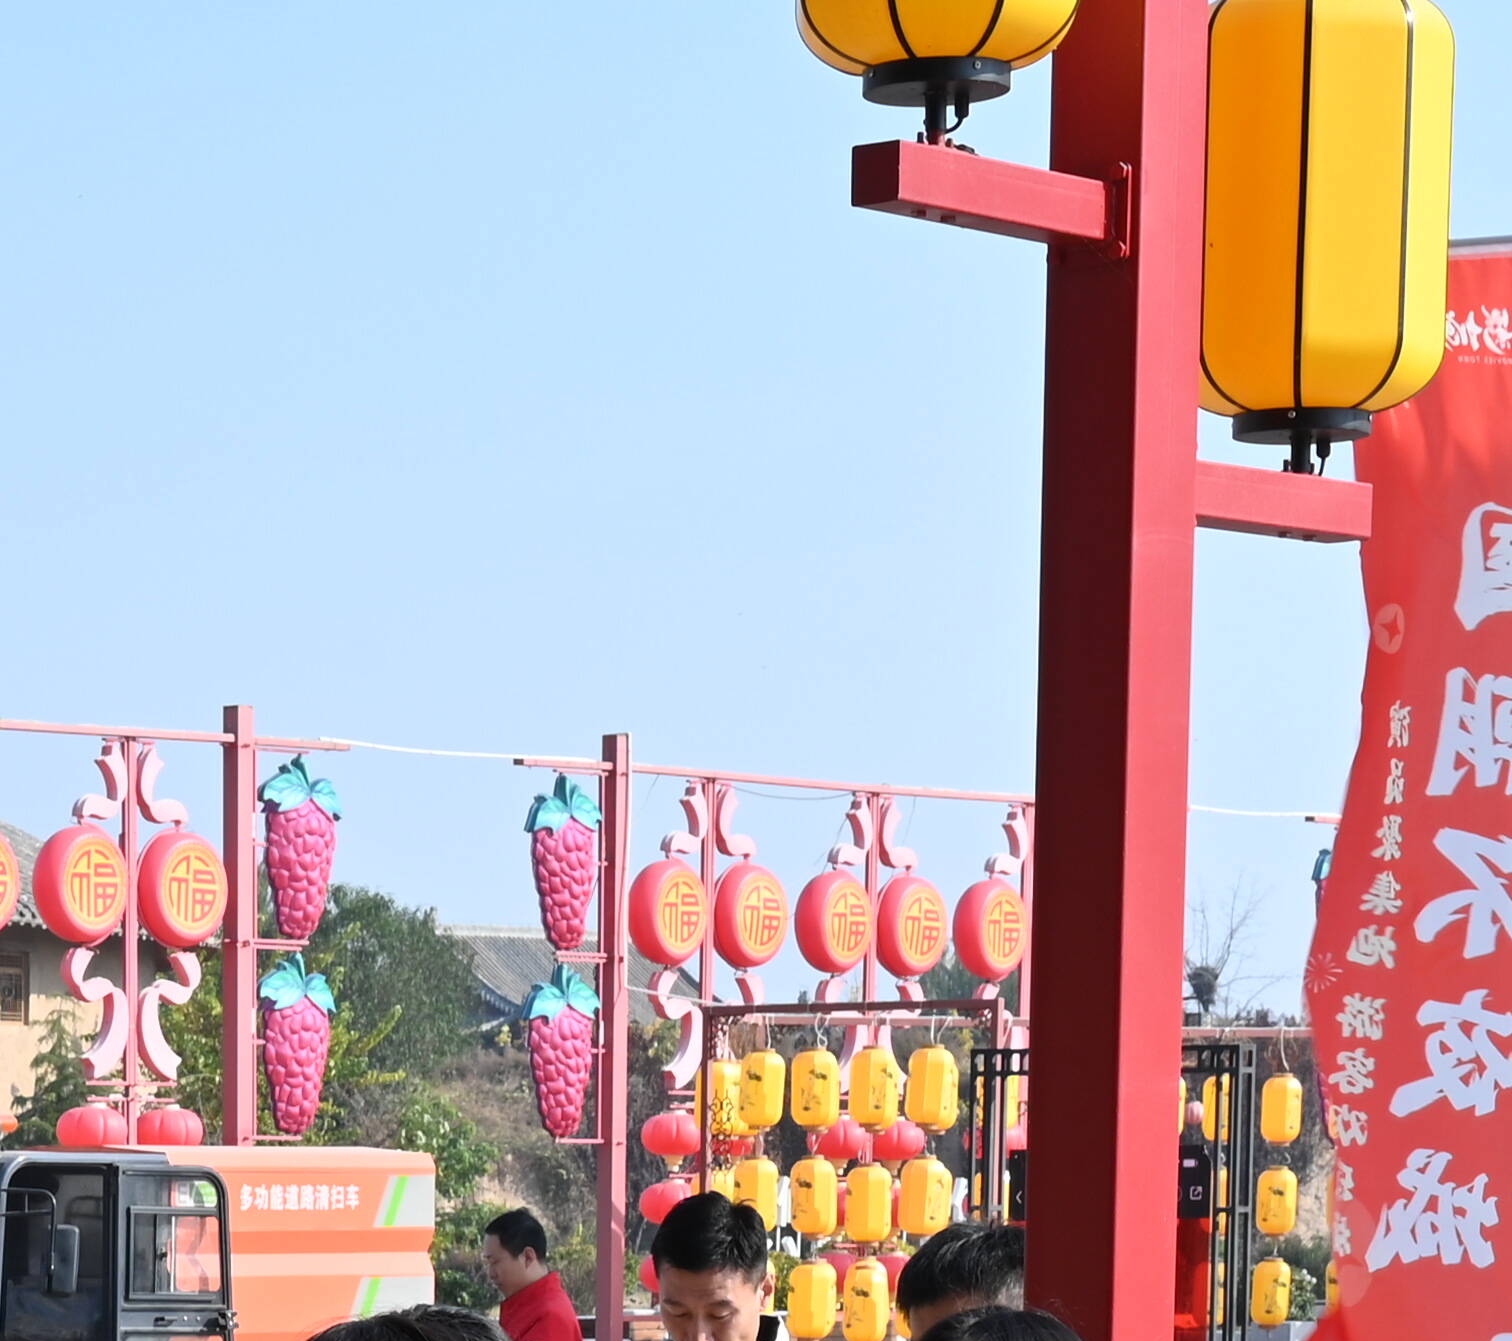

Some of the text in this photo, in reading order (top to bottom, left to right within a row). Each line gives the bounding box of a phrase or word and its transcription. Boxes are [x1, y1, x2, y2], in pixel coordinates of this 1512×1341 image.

[240, 1183, 361, 1212] 多功能道路清扫车
